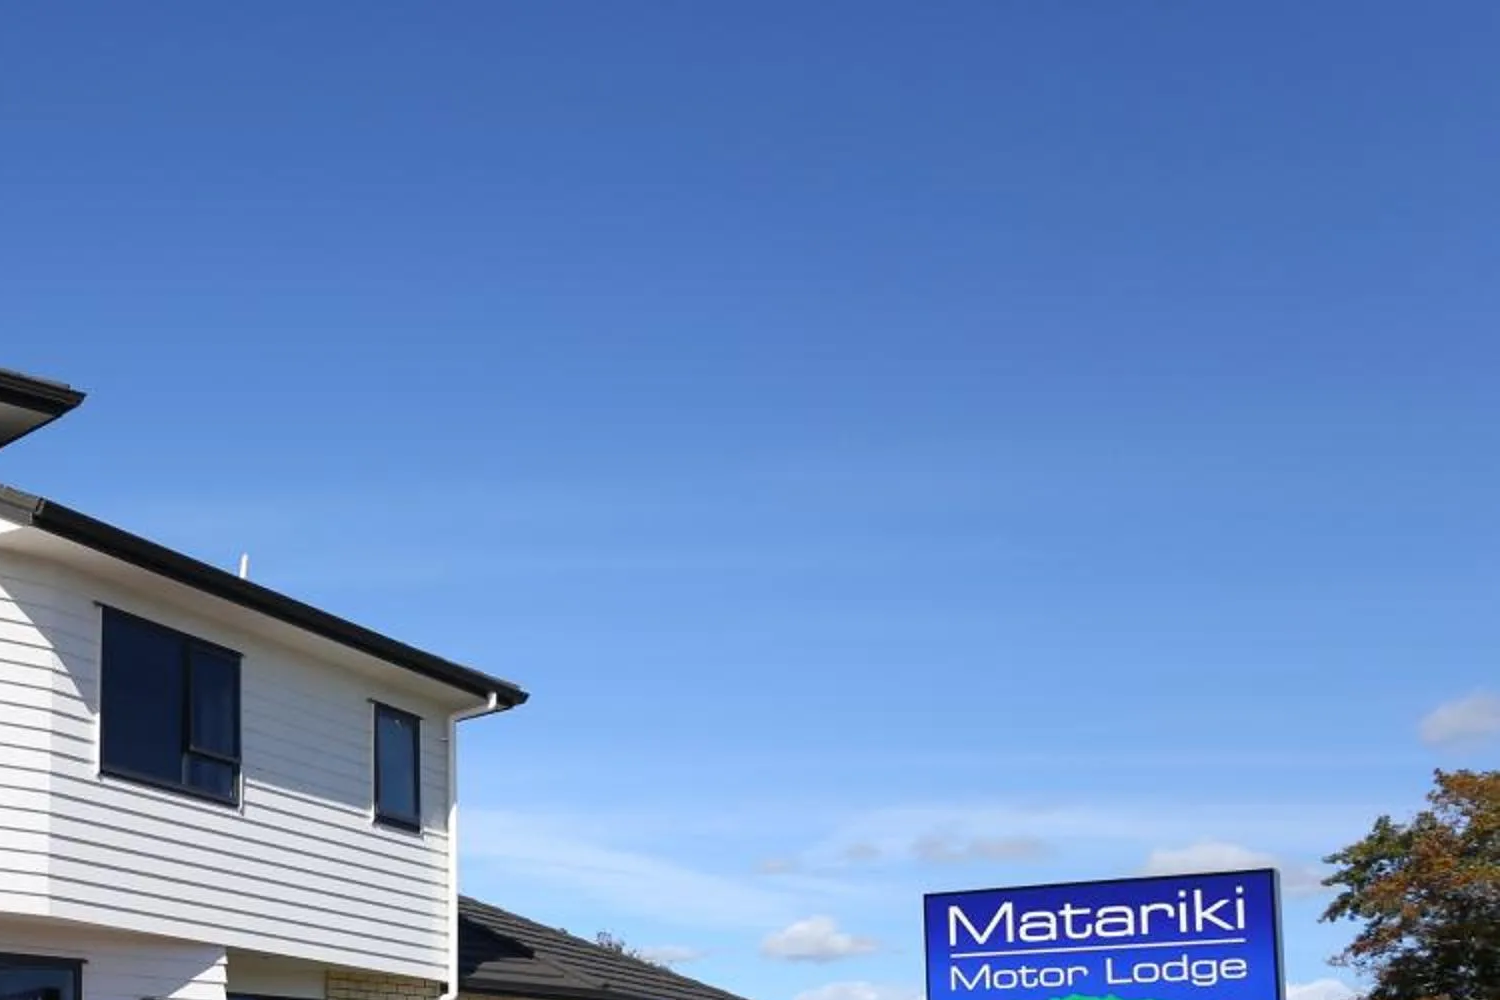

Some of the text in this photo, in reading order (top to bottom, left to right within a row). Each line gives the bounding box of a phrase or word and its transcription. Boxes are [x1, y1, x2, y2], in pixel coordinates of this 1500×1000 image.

[949, 886, 1246, 946] Matariki
[950, 954, 1248, 991] Motor Lodge
